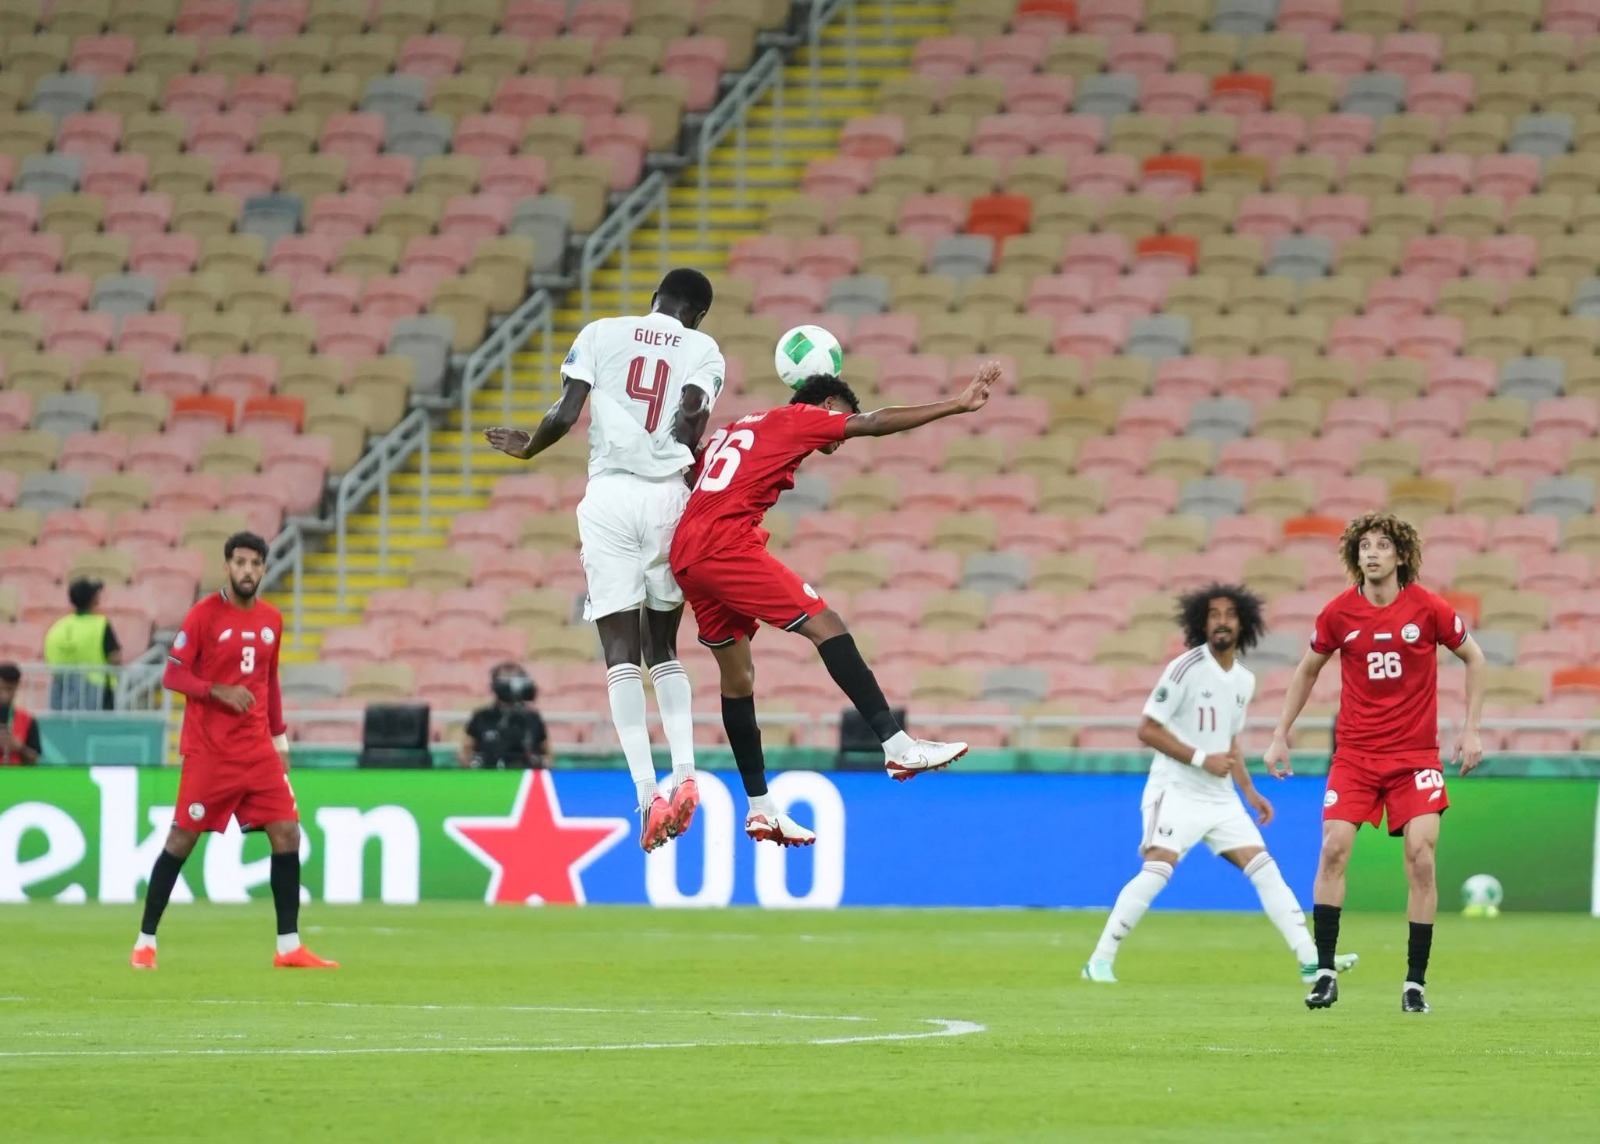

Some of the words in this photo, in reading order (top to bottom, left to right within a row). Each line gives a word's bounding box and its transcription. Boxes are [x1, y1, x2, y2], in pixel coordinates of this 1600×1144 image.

[634, 327, 682, 348] GUEYE
[626, 355, 671, 435] 4
[240, 646, 256, 674] 3
[1366, 651, 1403, 680] 26
[1198, 706, 1216, 732] 11
